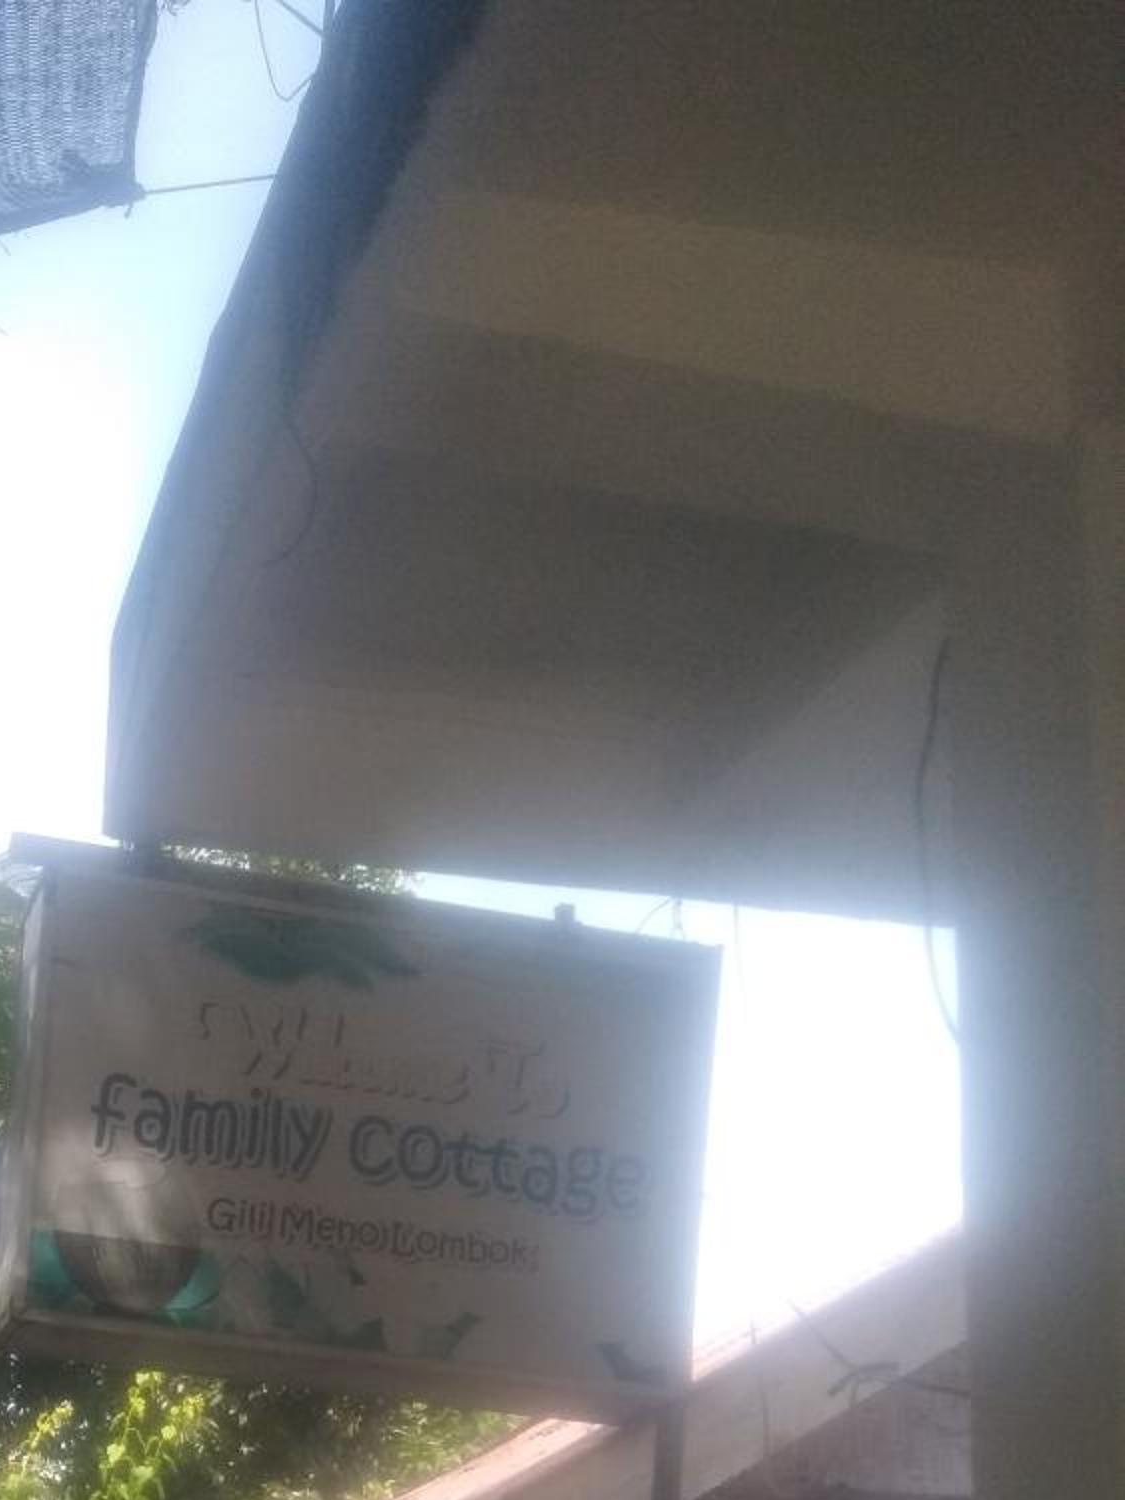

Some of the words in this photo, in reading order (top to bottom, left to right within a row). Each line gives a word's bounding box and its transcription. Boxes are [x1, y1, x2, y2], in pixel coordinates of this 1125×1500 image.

[207, 1197, 273, 1236] Gili
[280, 1204, 381, 1249] Meno
[390, 1220, 532, 1267] Lombok
